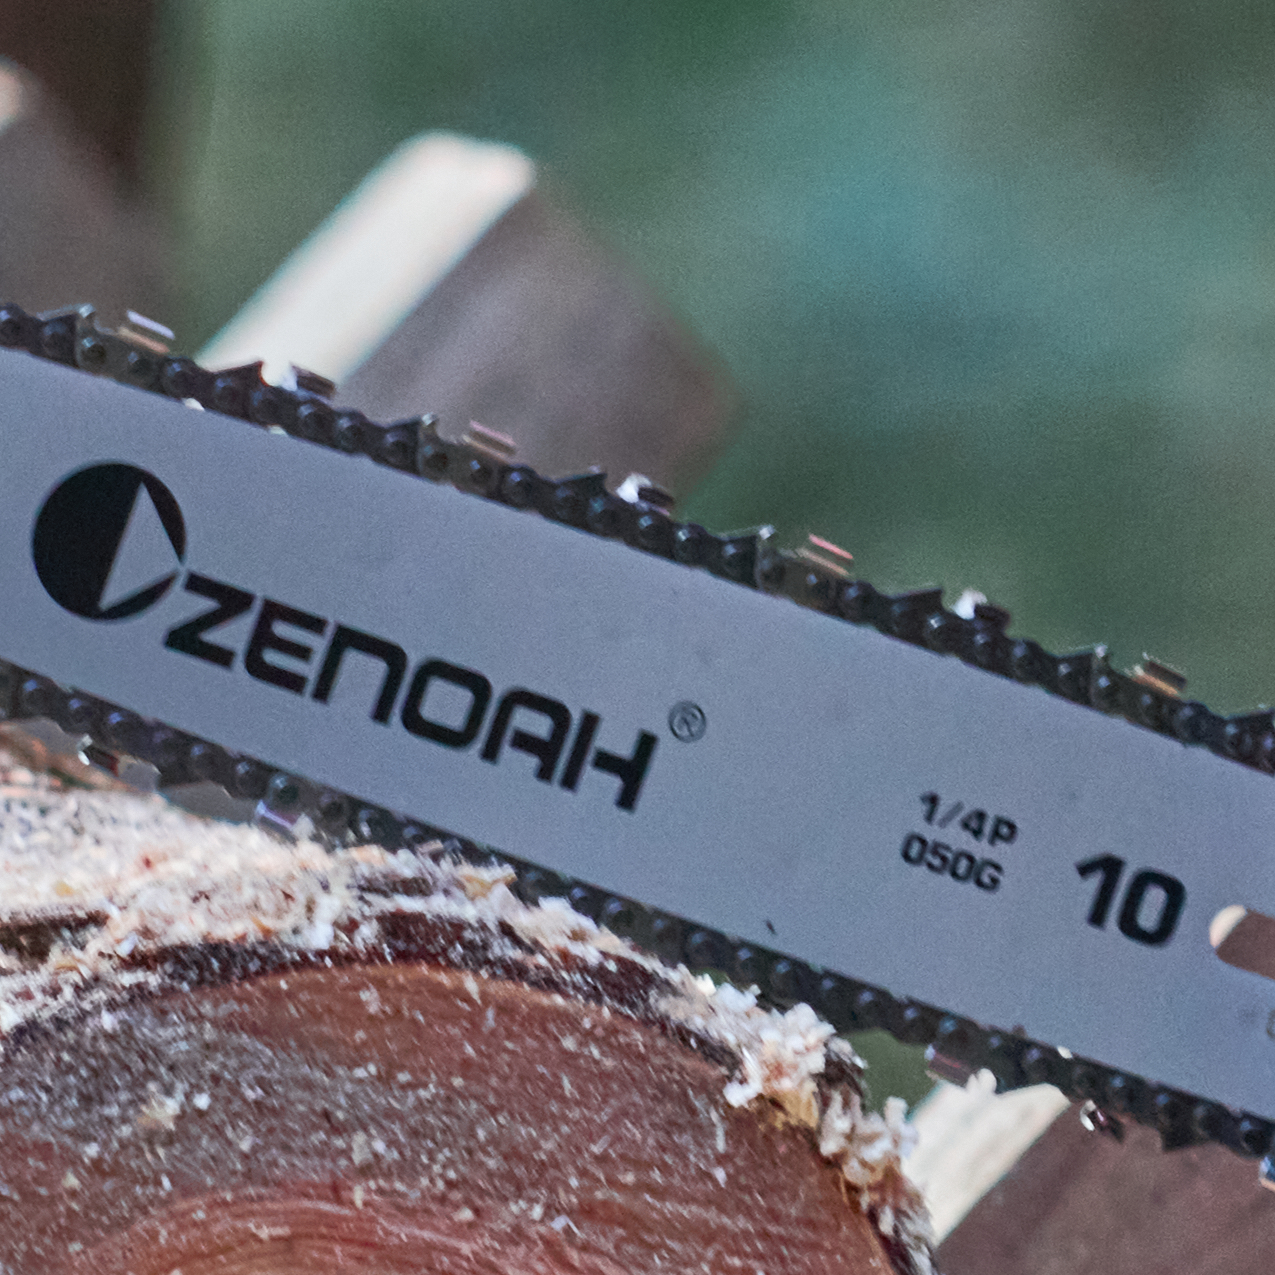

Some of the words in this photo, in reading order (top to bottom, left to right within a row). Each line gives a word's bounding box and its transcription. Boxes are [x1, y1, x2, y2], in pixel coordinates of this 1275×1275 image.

[163, 570, 659, 814] ZENOAH
[919, 791, 1018, 847] 1/4P
[900, 831, 1004, 894] 050G
[1075, 852, 1187, 949] 10
